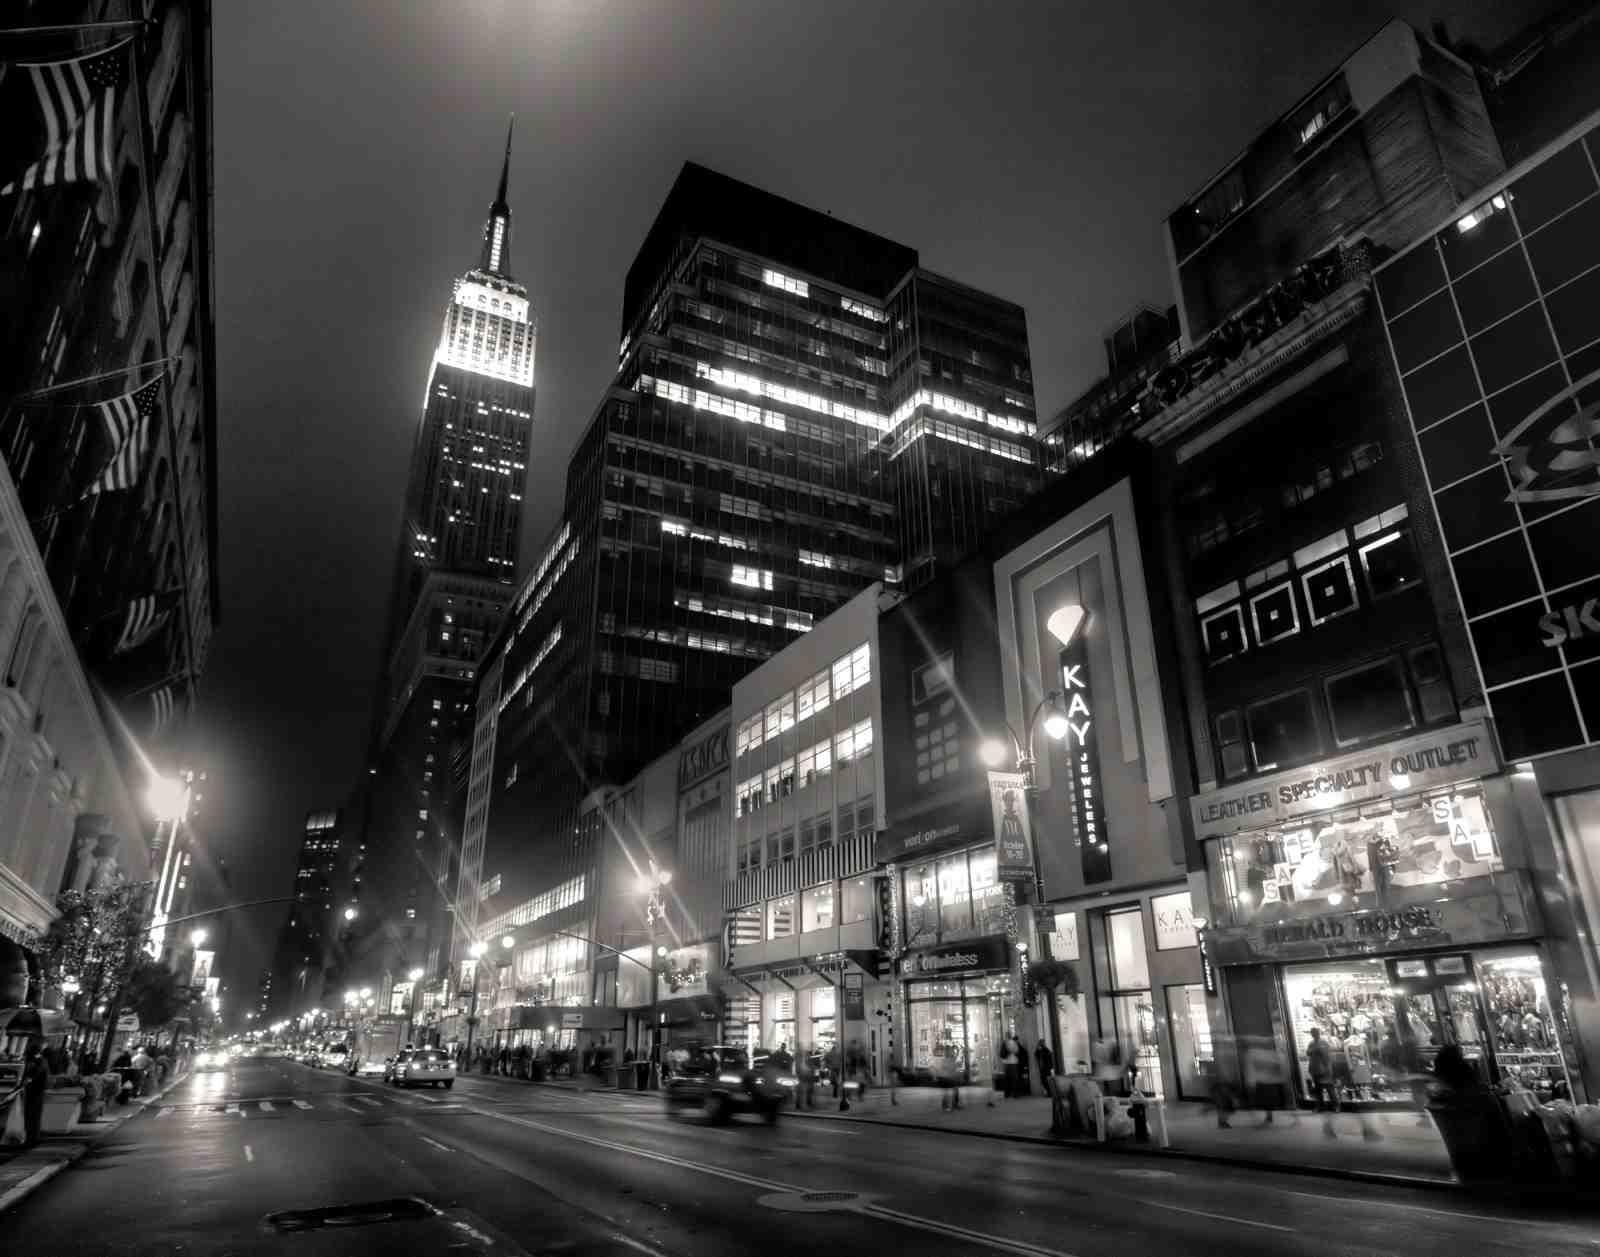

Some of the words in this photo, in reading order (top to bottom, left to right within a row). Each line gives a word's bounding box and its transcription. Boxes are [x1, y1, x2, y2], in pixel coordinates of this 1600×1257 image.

[1063, 664, 1091, 746] KAY
[1080, 752, 1097, 844] JEWELERS
[1201, 792, 1273, 823] LEATHER
[1279, 761, 1382, 805] SPECIALTY
[1391, 737, 1479, 776] OUTLET
